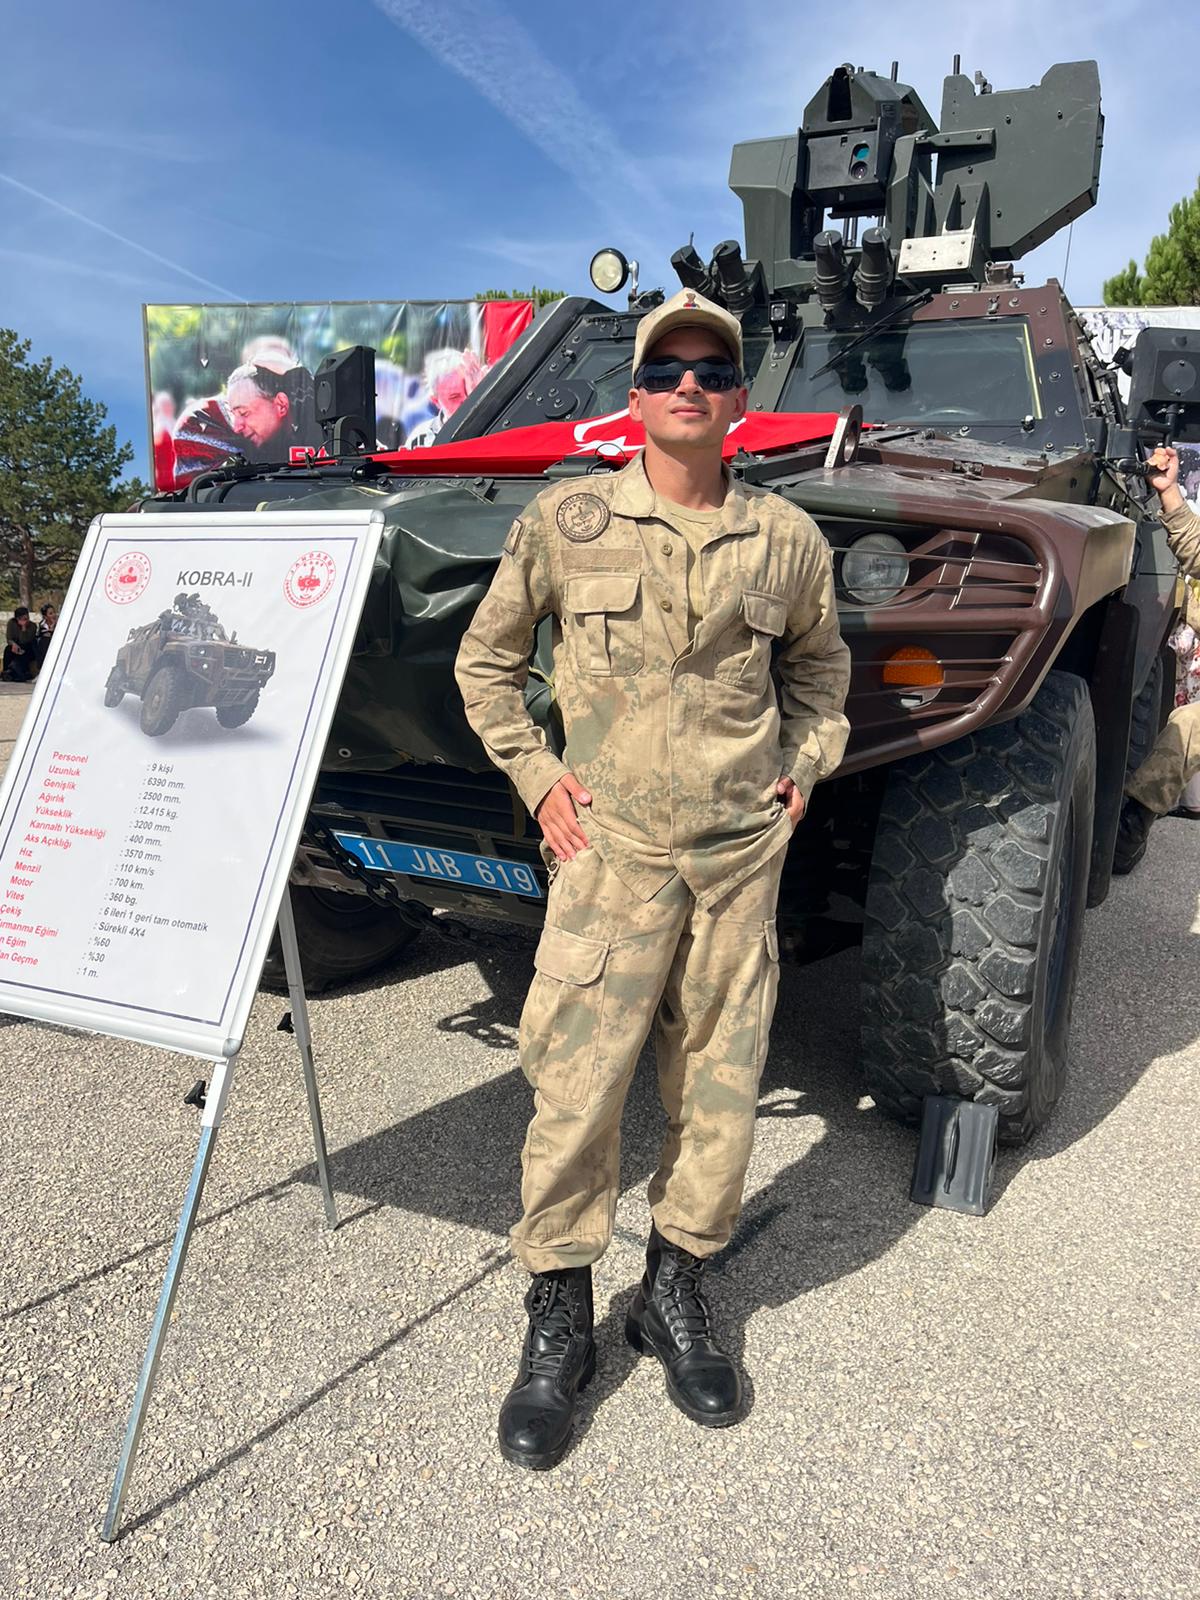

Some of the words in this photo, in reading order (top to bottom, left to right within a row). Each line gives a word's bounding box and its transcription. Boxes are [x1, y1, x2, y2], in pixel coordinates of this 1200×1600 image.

[176, 570, 253, 587] KOBRA-II
[53, 752, 88, 762] Personel
[152, 763, 157, 771] 9
[158, 764, 174, 774] kişi
[48, 765, 80, 776] Uzunluk
[147, 777, 166, 787] 6390
[168, 781, 185, 789] mm.
[44, 779, 76, 790] Genişlik
[143, 792, 162, 801] 2500
[163, 795, 181, 804] mm.
[35, 806, 73, 818] Yükseklik
[134, 820, 152, 830] 3200
[154, 824, 172, 832] mm.
[39, 793, 64, 802] Ağırlık
[139, 806, 164, 816] 12.415
[166, 809, 178, 820] kg.
[24, 834, 39, 843] Aks
[41, 836, 72, 849] Açıklığı
[124, 849, 143, 859] 3570
[144, 853, 162, 862] mm.
[65, 825, 106, 839] Yüksekliği
[129, 835, 143, 844] 400
[144, 838, 162, 846] mm.
[19, 848, 32, 857] Hız
[120, 864, 133, 872] 110
[134, 865, 154, 876] km/s
[358, 842, 392, 867] 11
[411, 849, 462, 878] JAB
[476, 860, 533, 892] 619
[15, 862, 41, 872] Menzil
[115, 878, 128, 887] 700
[130, 880, 144, 890] km.
[10, 876, 33, 887] Motor
[109, 892, 123, 902] 360
[125, 895, 137, 906] bg.
[0, 904, 22, 916] Çekiş
[99, 922, 127, 934] Sürekli
[129, 927, 145, 937] 4X4
[6, 890, 24, 900] Vites
[104, 907, 109, 916] 6
[110, 908, 127, 919] ileri
[134, 914, 153, 923] geri
[153, 916, 170, 925] tam
[171, 919, 208, 932] otomatik
[0, 920, 33, 933] ırmanma
[35, 926, 58, 937] Eğimi
[93, 937, 110, 947] %60
[6, 936, 26, 947] Eğim
[88, 952, 105, 962] %30
[11, 953, 38, 965] Geçme
[88, 969, 98, 977] m.
